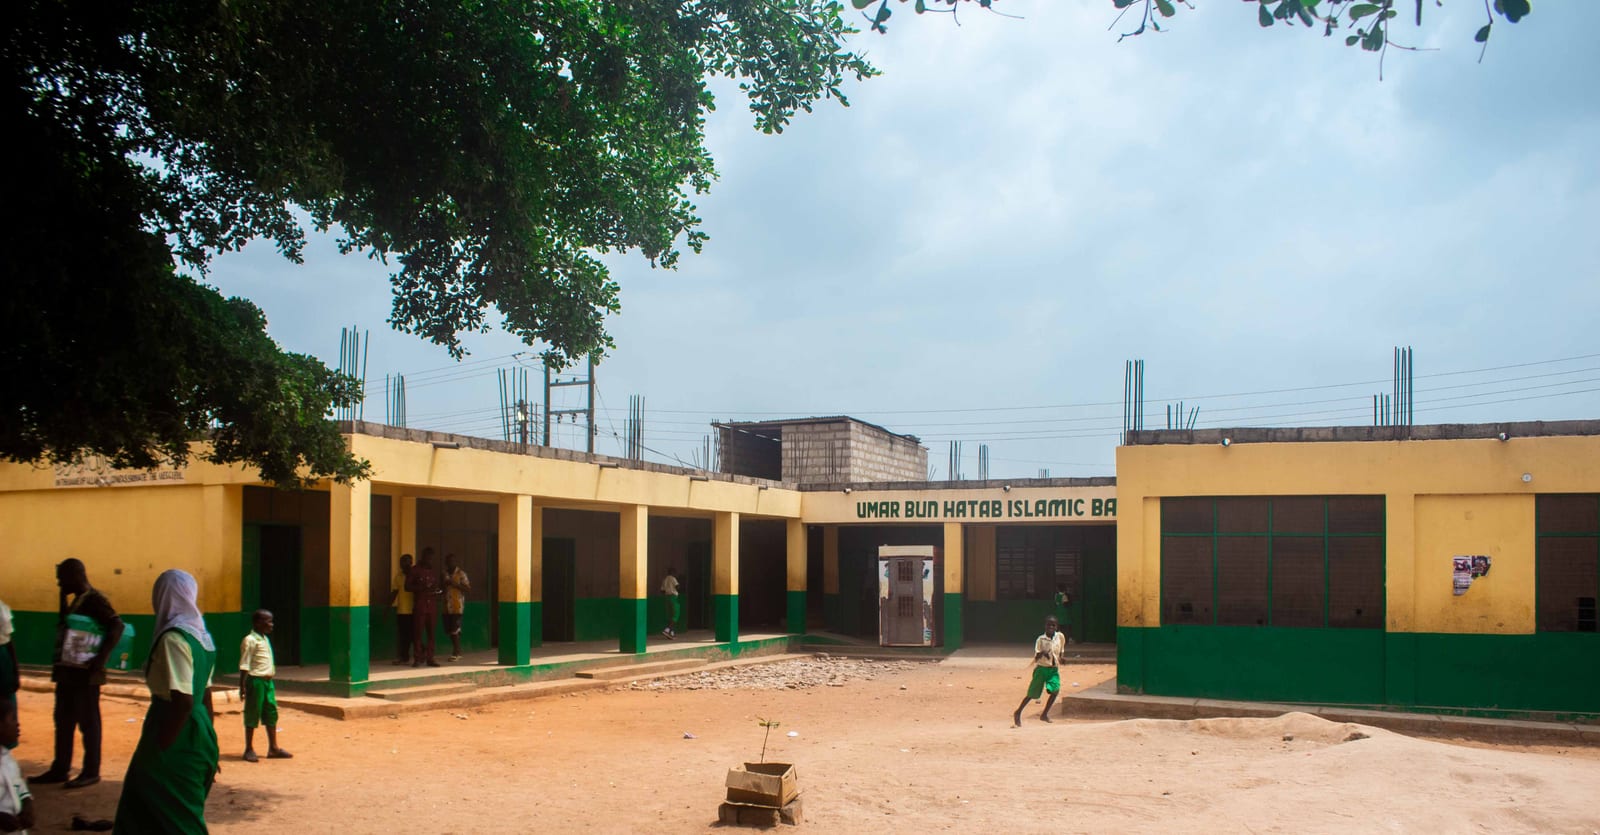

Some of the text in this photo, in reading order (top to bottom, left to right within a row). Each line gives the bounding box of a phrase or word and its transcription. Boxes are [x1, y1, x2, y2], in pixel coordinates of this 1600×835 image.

[856, 501, 900, 518] UMAR
[904, 500, 939, 518] BUN
[943, 500, 1003, 518] HATAB
[1007, 499, 1085, 518] ISLAMIC
